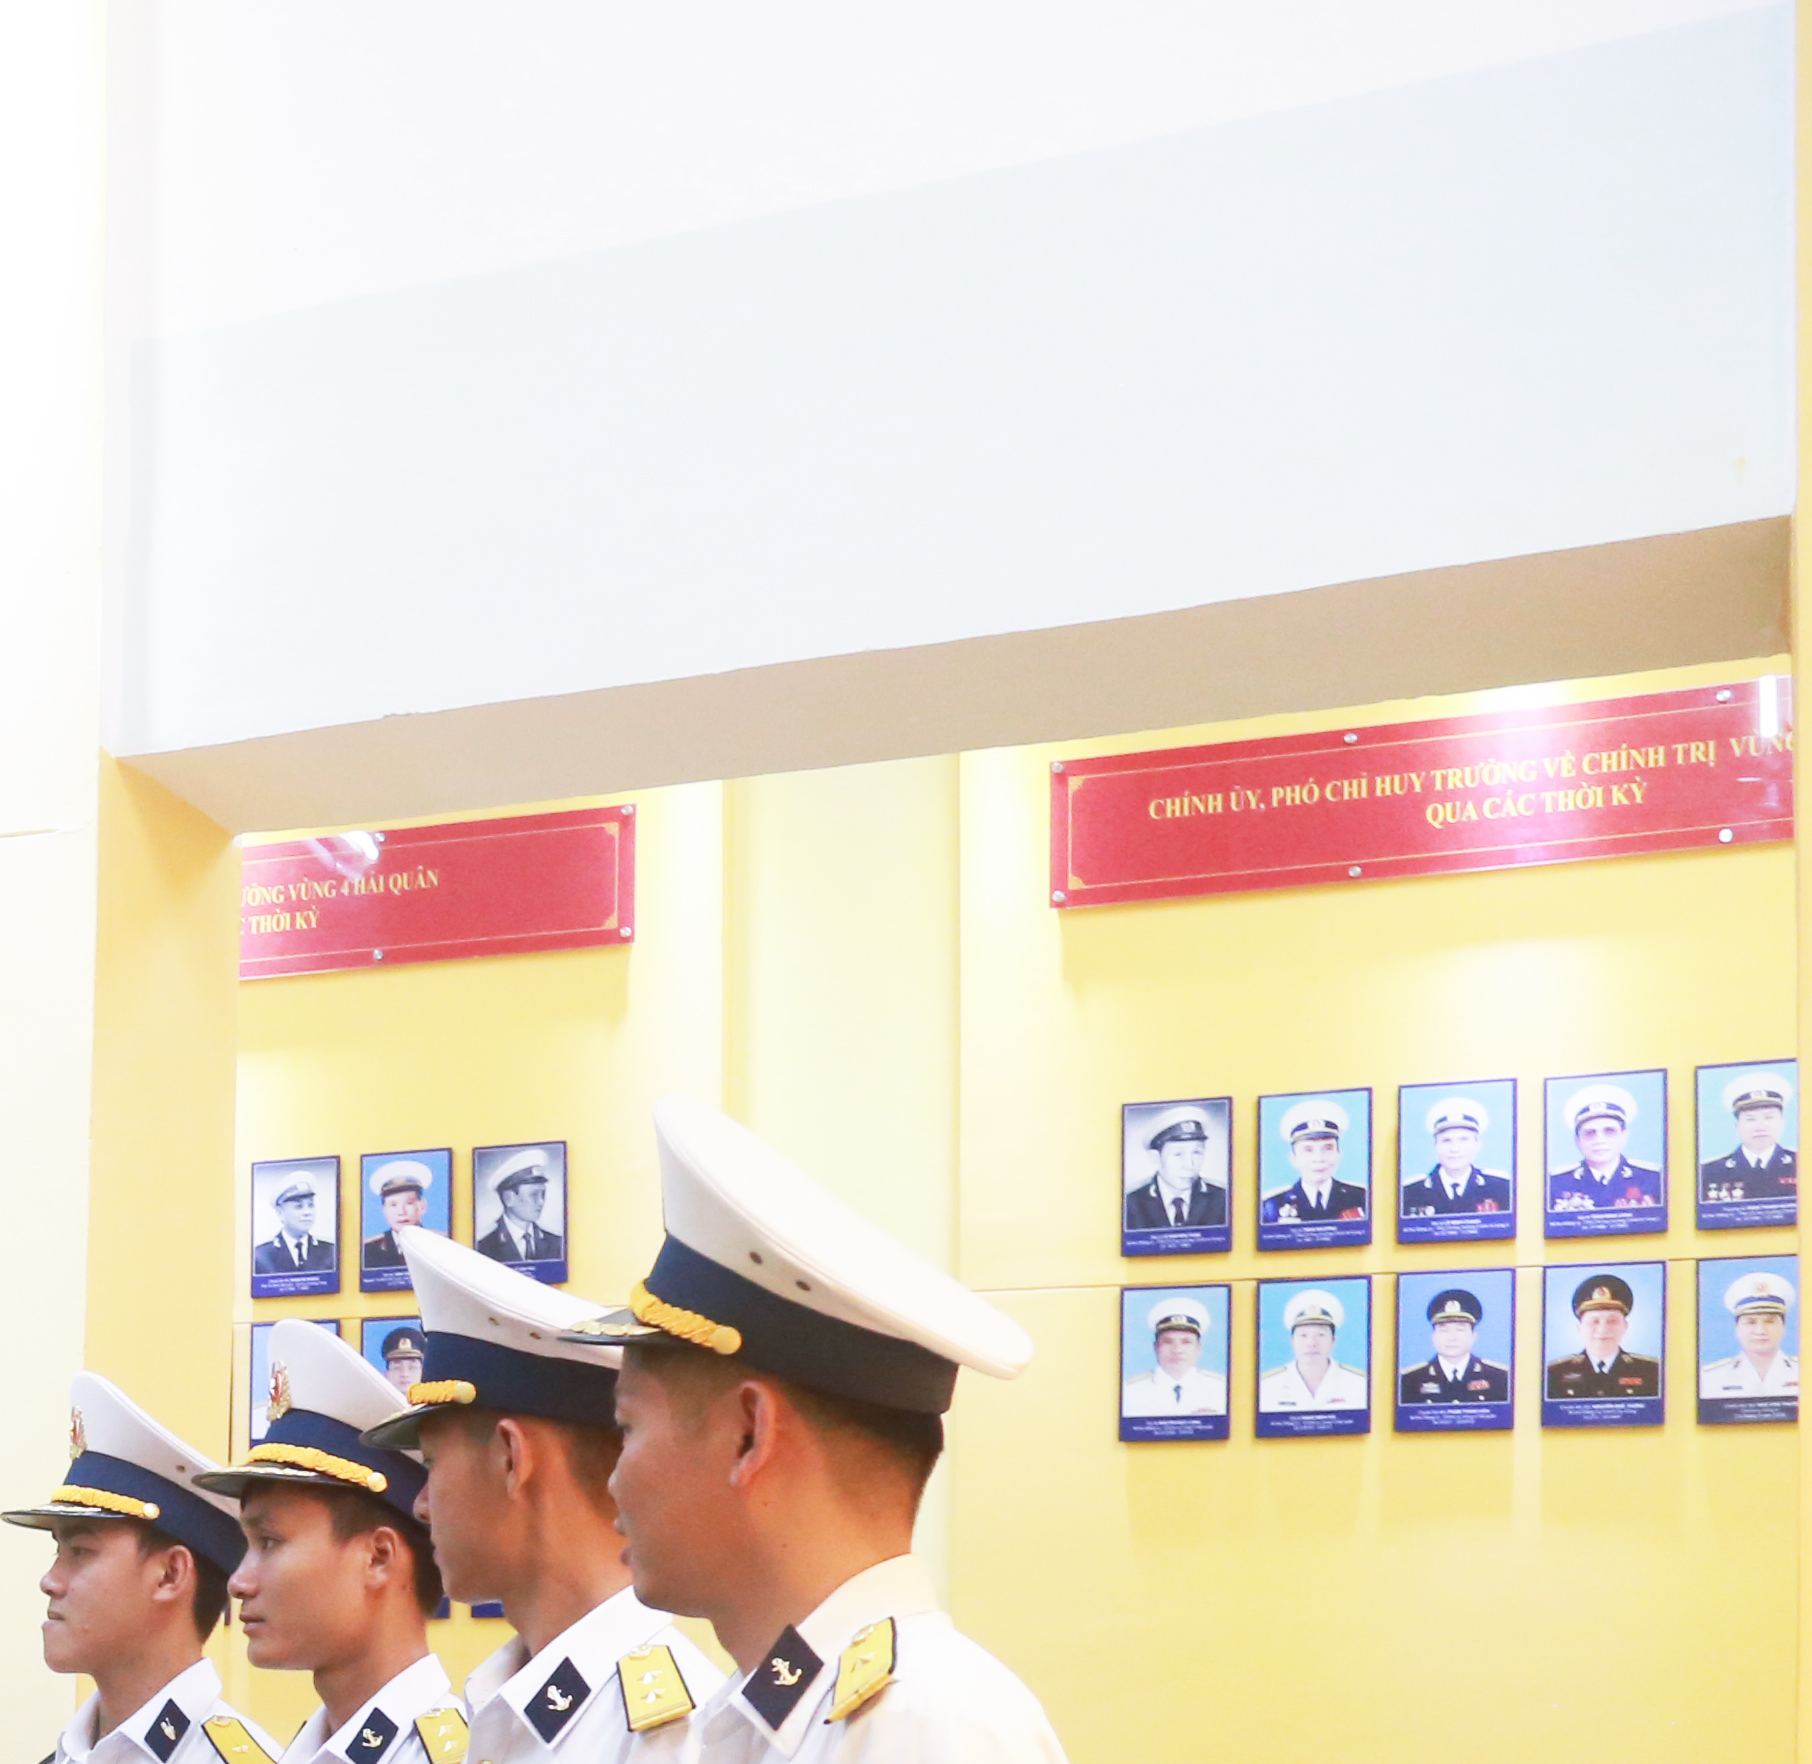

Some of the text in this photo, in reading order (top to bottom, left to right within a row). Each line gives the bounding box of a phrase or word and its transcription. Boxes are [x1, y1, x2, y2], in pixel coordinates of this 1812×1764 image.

[1148, 791, 1224, 820] CHÍNH
[1271, 776, 1321, 807] PHÓ
[1325, 767, 1369, 802] CHỈ
[1374, 772, 1426, 797] HUY
[1431, 758, 1538, 791] TRƯỞNG
[1542, 744, 1577, 778] VỀ
[1582, 743, 1666, 775] CHÍNH
[1673, 739, 1718, 767] TRỊ
[1424, 776, 1648, 829] QUA CÁC THỜI KỲ
[288, 877, 338, 902] VÙNG
[340, 880, 352, 897] 4
[353, 869, 386, 896] HẢI
[389, 865, 440, 896] QUÂN
[248, 908, 292, 935] THỜI
[294, 904, 320, 930] KỲ
